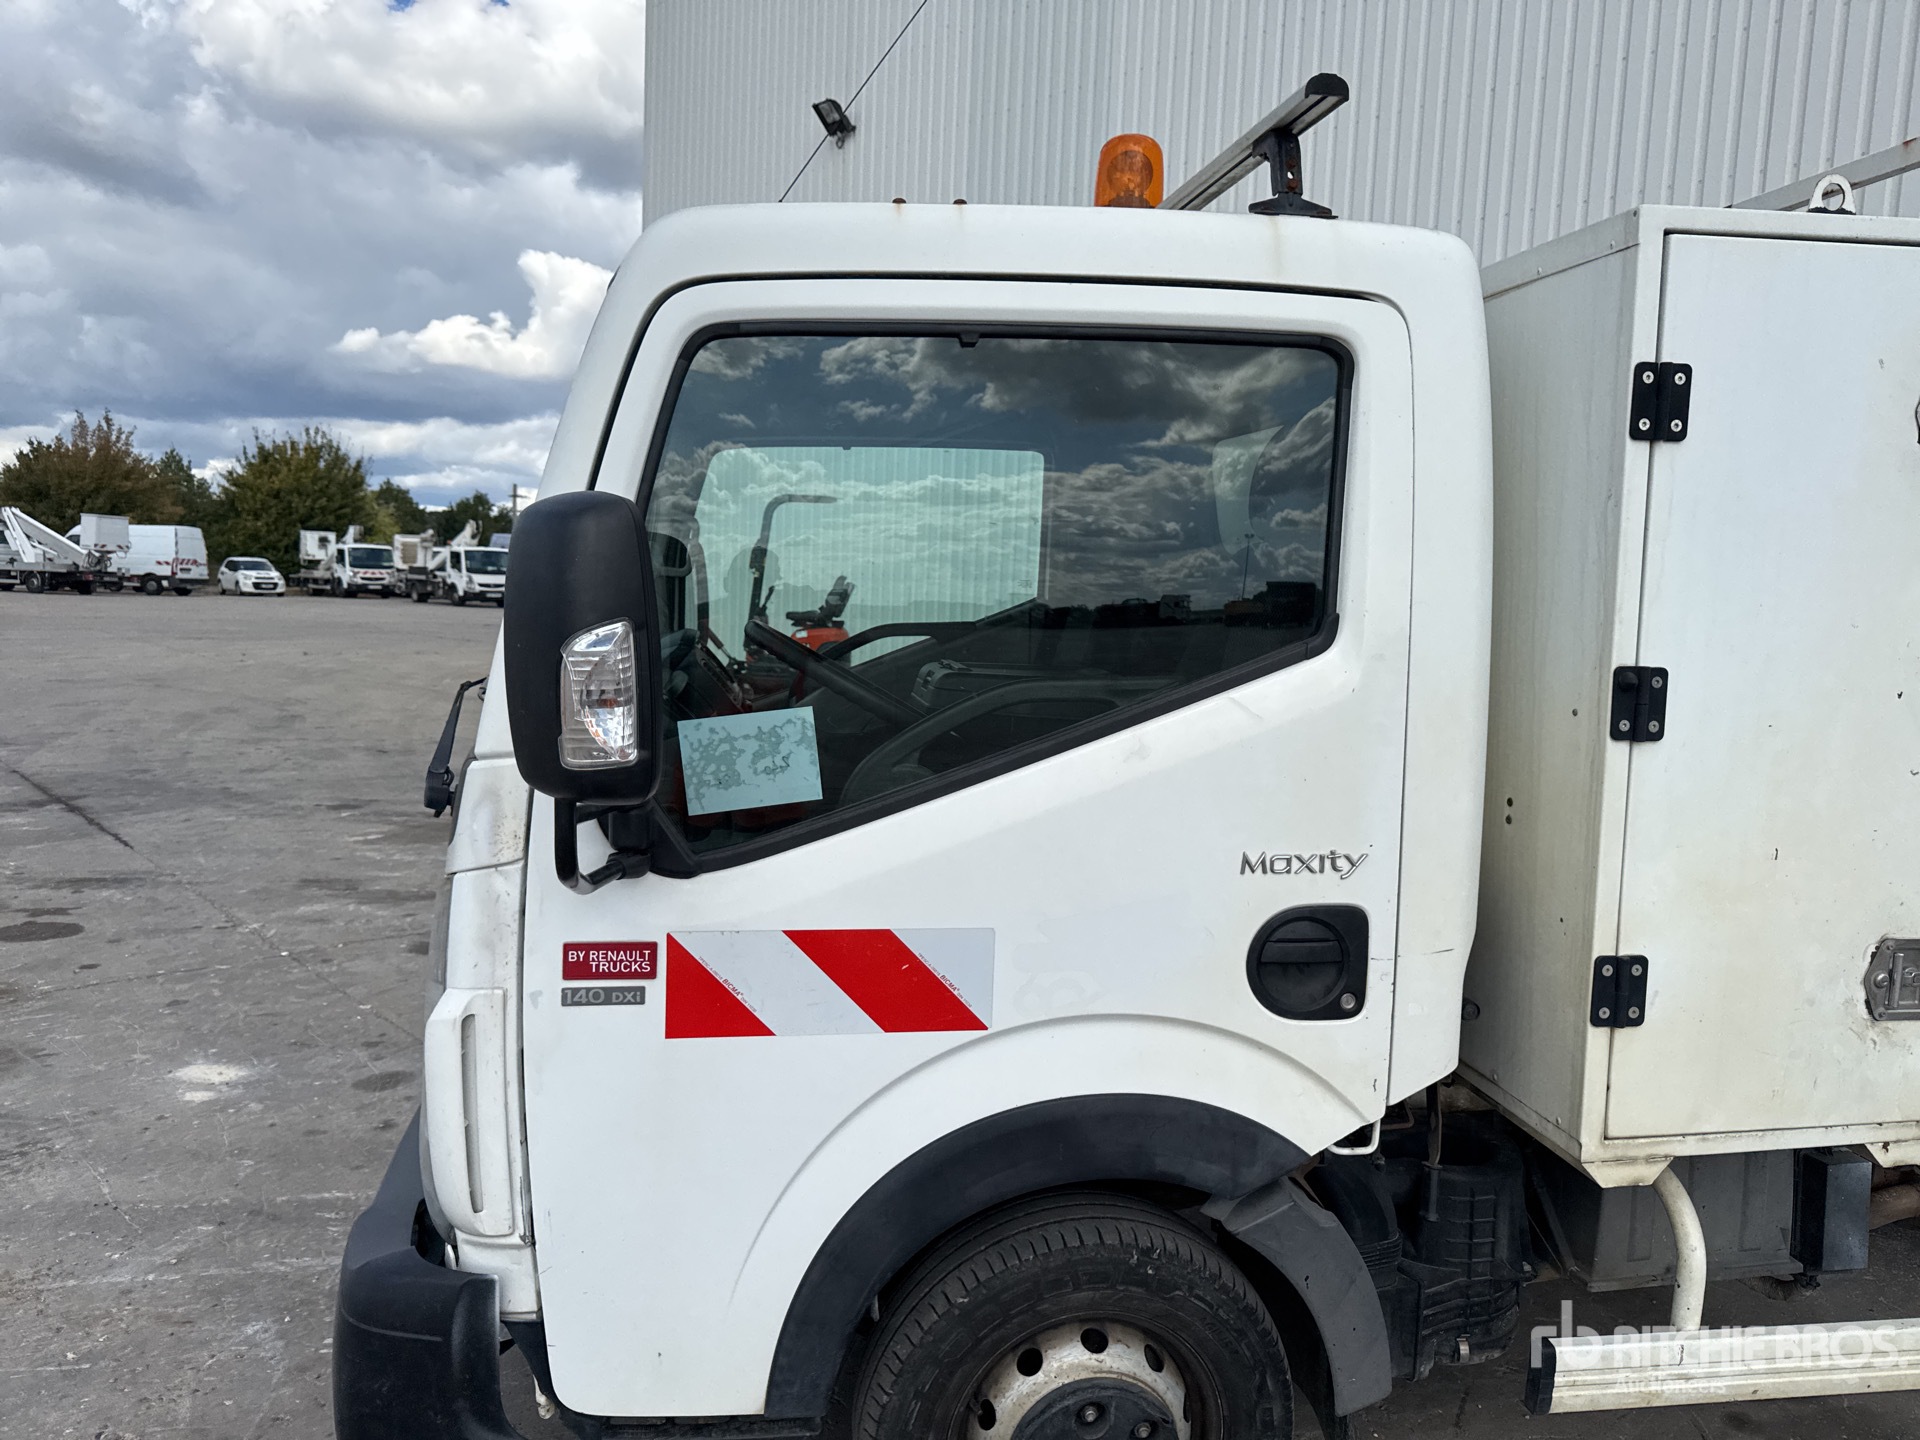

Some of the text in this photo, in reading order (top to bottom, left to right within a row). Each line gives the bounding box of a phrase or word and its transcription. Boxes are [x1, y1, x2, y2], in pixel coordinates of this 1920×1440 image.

[1240, 849, 1368, 880] Maxity
[568, 950, 651, 962] BY RENAULT
[590, 961, 651, 973] TRUCKS
[564, 988, 605, 1004] 140
